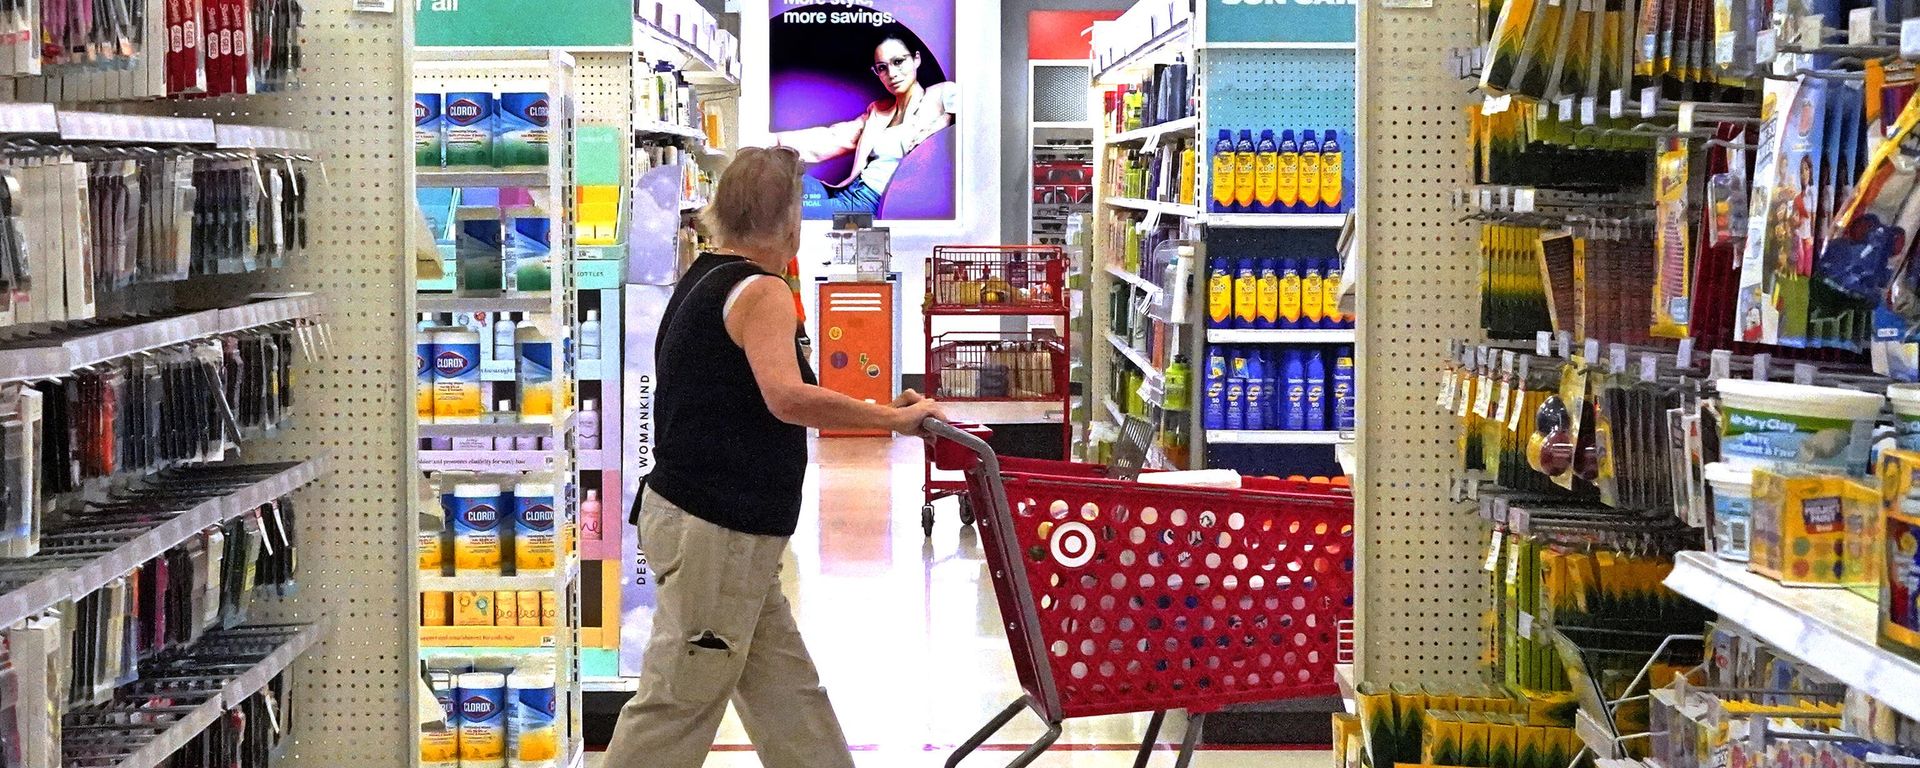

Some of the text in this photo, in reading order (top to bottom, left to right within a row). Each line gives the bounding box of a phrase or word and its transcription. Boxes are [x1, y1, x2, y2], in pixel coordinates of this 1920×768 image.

[783, 8, 896, 27] more savings.
[449, 106, 477, 117] CLOROX
[437, 358, 464, 369] CLOROX
[638, 374, 650, 469] WOMANKIND
[1766, 418, 1797, 434] Clay
[468, 511, 496, 521] CLOROX
[525, 511, 554, 521] CLOROX
[463, 702, 491, 713] CLOROX
